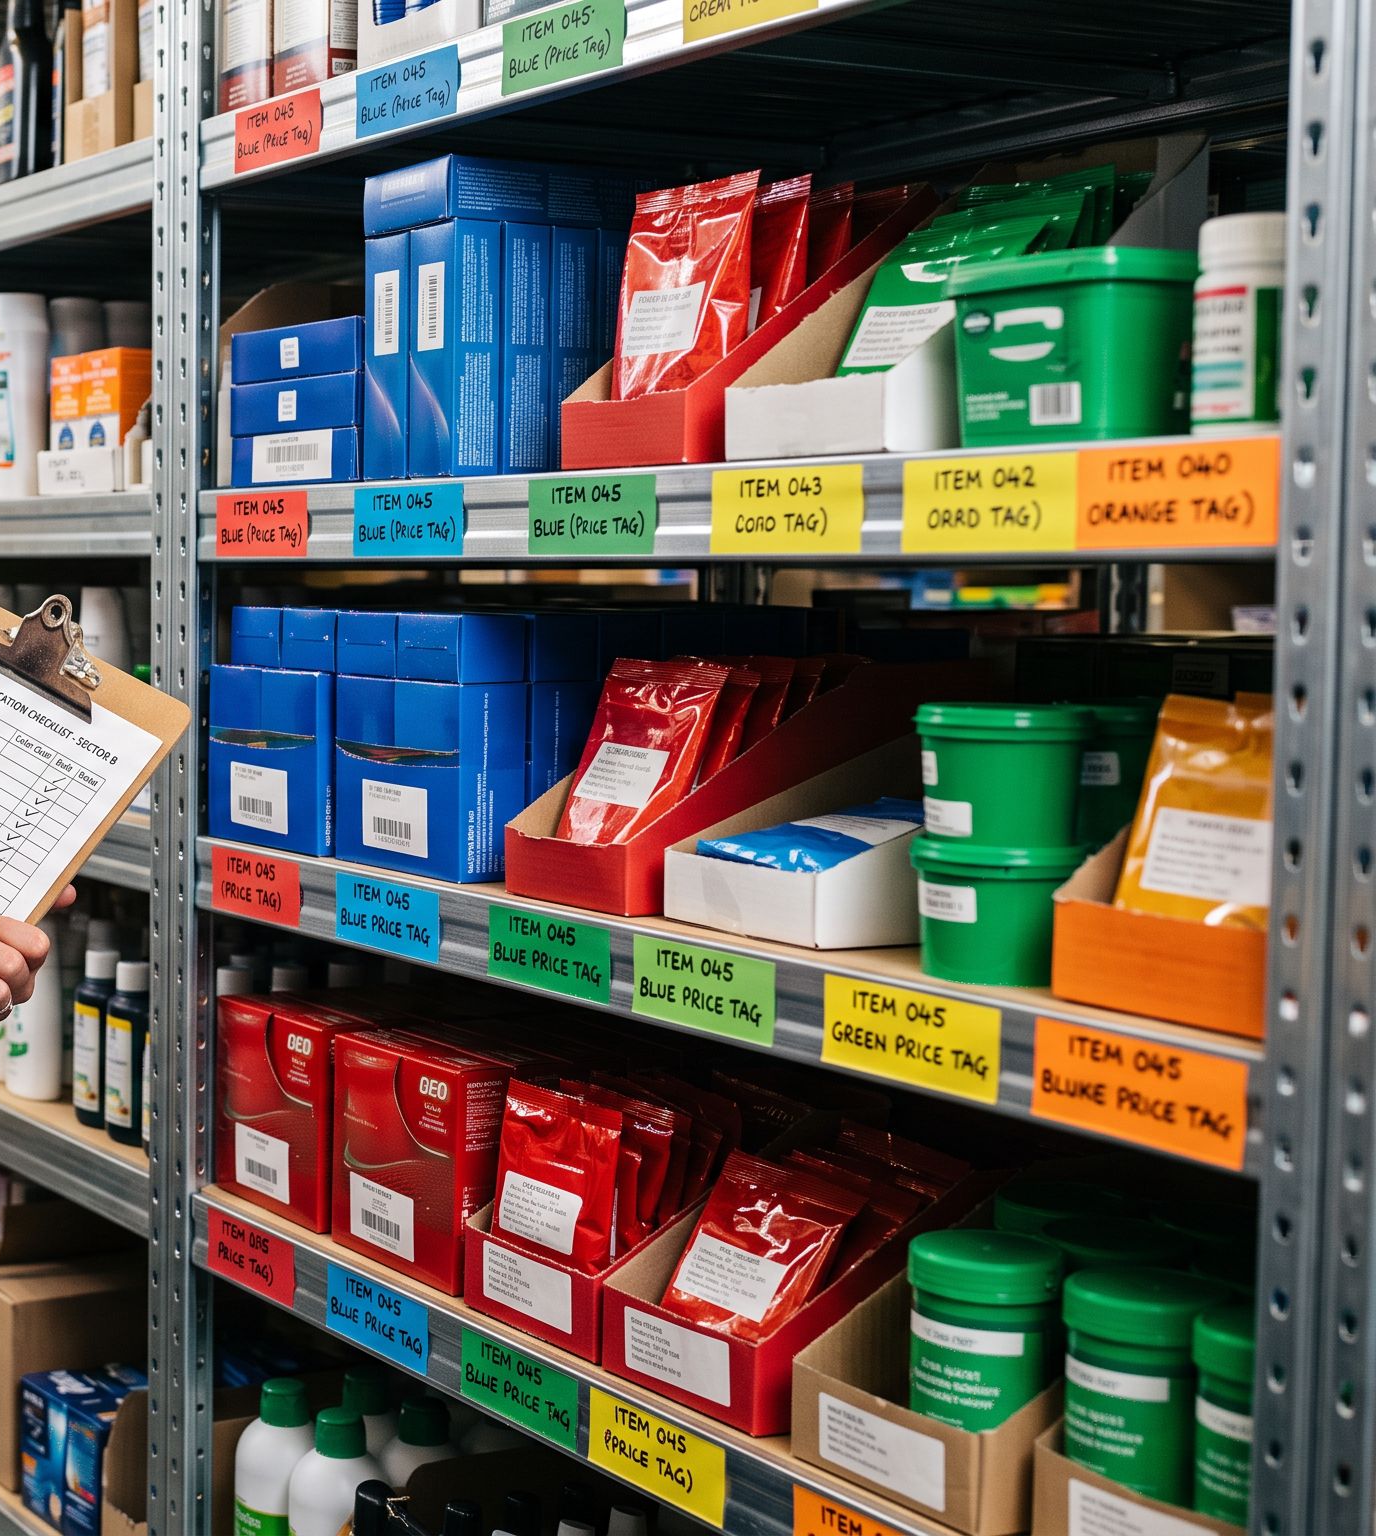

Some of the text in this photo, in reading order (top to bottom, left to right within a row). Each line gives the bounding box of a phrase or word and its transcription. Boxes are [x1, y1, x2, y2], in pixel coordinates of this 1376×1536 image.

[520, 18, 554, 43] ITEM
[369, 60, 426, 93] ITEM 045
[508, 53, 540, 79] BLUE
[246, 111, 269, 129] ITEM
[236, 140, 260, 159] BLUE
[934, 466, 1035, 491] ITEM 042
[1107, 457, 1165, 482] ITEM
[372, 492, 433, 511] ITEM 045
[550, 483, 622, 505] ITEM 045
[739, 476, 822, 498] ITEM 043
[232, 498, 285, 516] ITEM 045
[782, 507, 828, 536] TAG)
[989, 501, 1041, 530] TAG)
[1087, 490, 1255, 528] ORANGE TAG)
[220, 528, 244, 545] BLUE
[357, 515, 456, 543] BLUE (PRICE TAG)
[532, 510, 645, 540] BLUE (PRICE TAG)
[27, 709, 74, 740] CHECKLIST
[75, 736, 111, 762] SECTOR
[109, 755, 118, 766] B
[226, 856, 276, 882] ITEM 045
[220, 880, 282, 913] (PRICE TAG)
[352, 882, 410, 911] ITEM 045
[339, 907, 431, 948] BLUE PRICE TAG
[508, 915, 576, 947] ITEM 045
[492, 941, 603, 988] BLUE PRICE TAG
[655, 948, 734, 983] ITEM 045
[638, 976, 763, 1028] BLUE PRICE TAG
[852, 991, 946, 1028] ITEM 045
[831, 1021, 989, 1080] GREEN PRICE TAG
[1069, 1036, 1181, 1080] ITEM 045
[1040, 1068, 1232, 1138] BLUKE PRICE TAG
[221, 1219, 246, 1242] ITEM
[216, 1240, 274, 1287] PRICE TAG)
[344, 1276, 373, 1302] ITEM
[329, 1295, 359, 1324] BLUE
[363, 1311, 396, 1343] PRICE
[480, 1341, 543, 1386] ITEM 045
[502, 1379, 540, 1414] PRICE
[613, 1405, 687, 1454] ITEM 045
[654, 1456, 693, 1494] TAG)
[821, 1505, 863, 1536] ITEM
